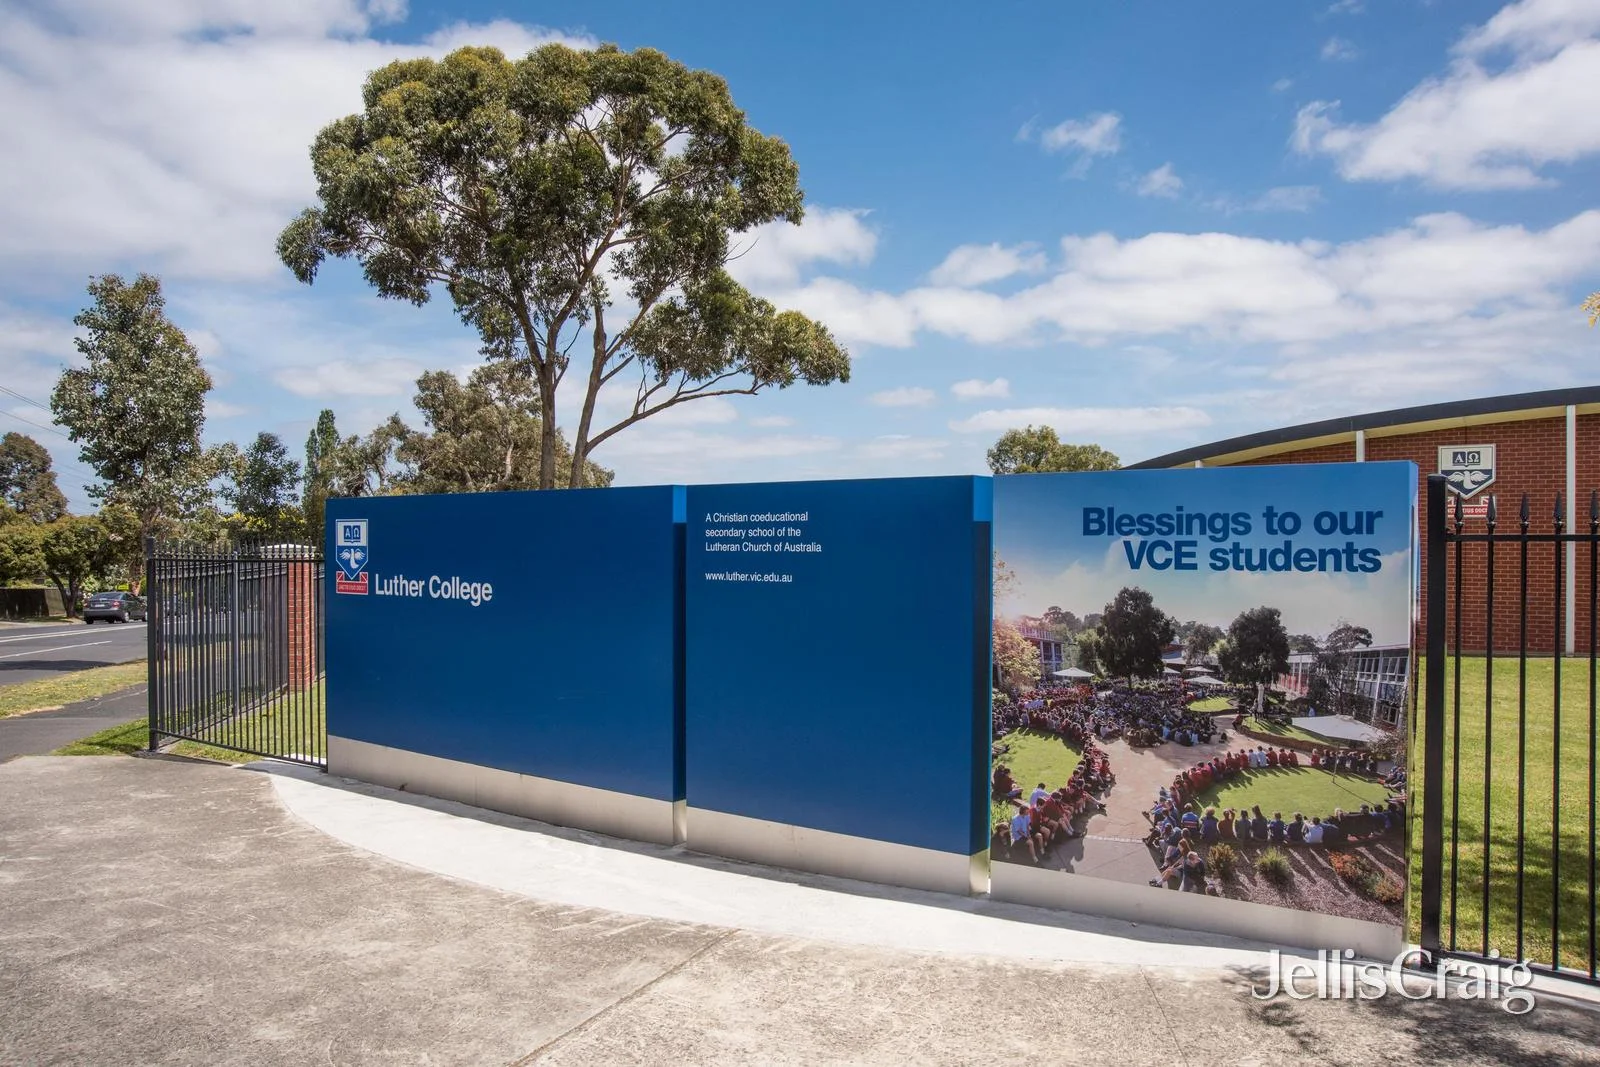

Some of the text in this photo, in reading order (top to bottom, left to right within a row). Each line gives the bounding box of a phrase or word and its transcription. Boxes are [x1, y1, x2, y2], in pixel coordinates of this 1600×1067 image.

[705, 511, 808, 523] A Christian coeducational
[1082, 506, 1383, 542] Blessings to our
[705, 527, 801, 539] secondary school of the
[705, 542, 822, 552] Lutheran Church of Australia
[1123, 540, 1382, 573] VCE students
[705, 571, 792, 583] www.luther.vic.edu.au
[375, 573, 493, 607] Luther College
